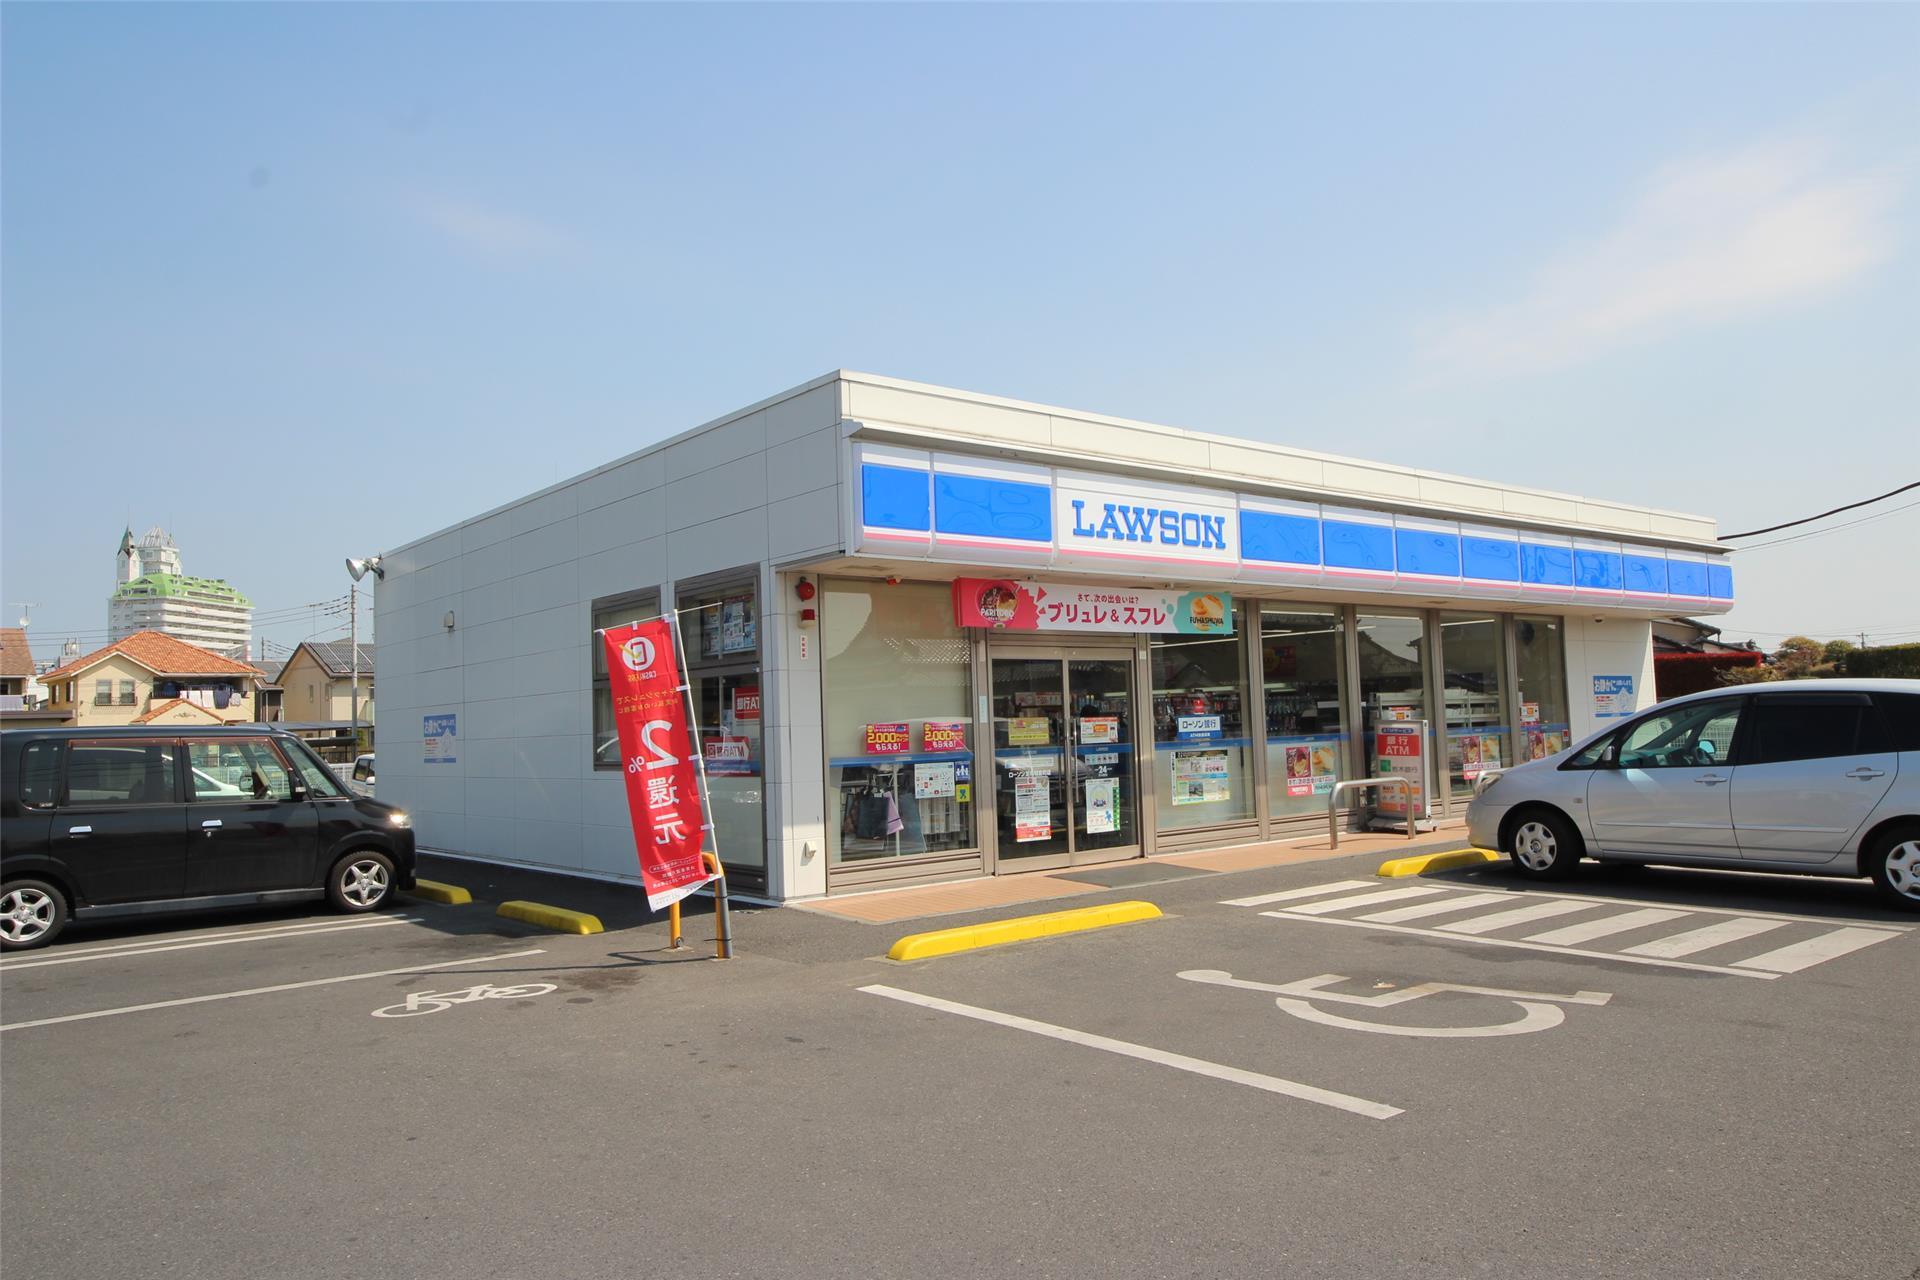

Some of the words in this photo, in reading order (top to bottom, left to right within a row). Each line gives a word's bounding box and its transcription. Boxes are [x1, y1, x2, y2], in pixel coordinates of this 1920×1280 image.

[1072, 500, 1226, 550] LAWSON
[1077, 593, 1139, 605] さて、次の出会いは?
[737, 696, 760, 710] 銀行AT
[1183, 720, 1216, 729] ローソン銀行
[1385, 746, 1409, 755] ATM
